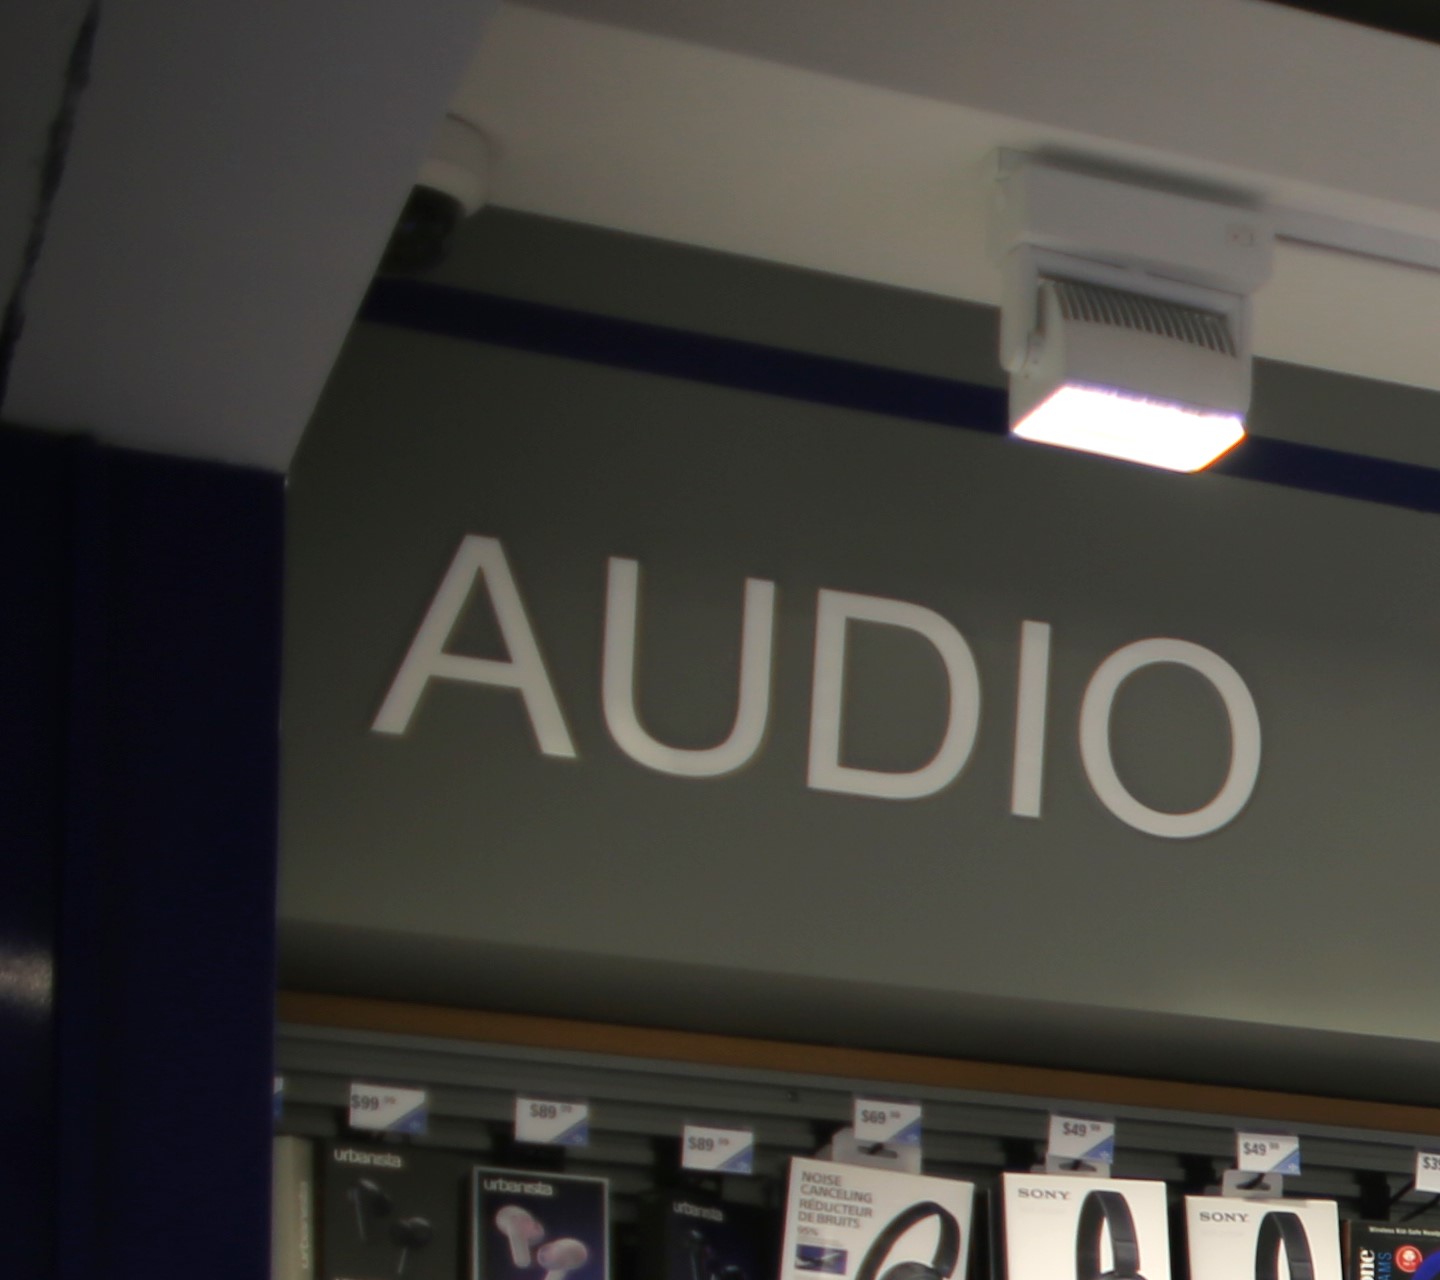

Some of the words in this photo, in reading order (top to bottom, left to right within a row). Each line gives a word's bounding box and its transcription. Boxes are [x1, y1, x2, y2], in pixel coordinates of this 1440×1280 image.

[370, 531, 1263, 842] AUDIO
[801, 1172, 842, 1187] NOISE
[801, 1184, 872, 1204] CANCELING
[1017, 1187, 1070, 1200] SONY
[1200, 1211, 1249, 1223] SONY
